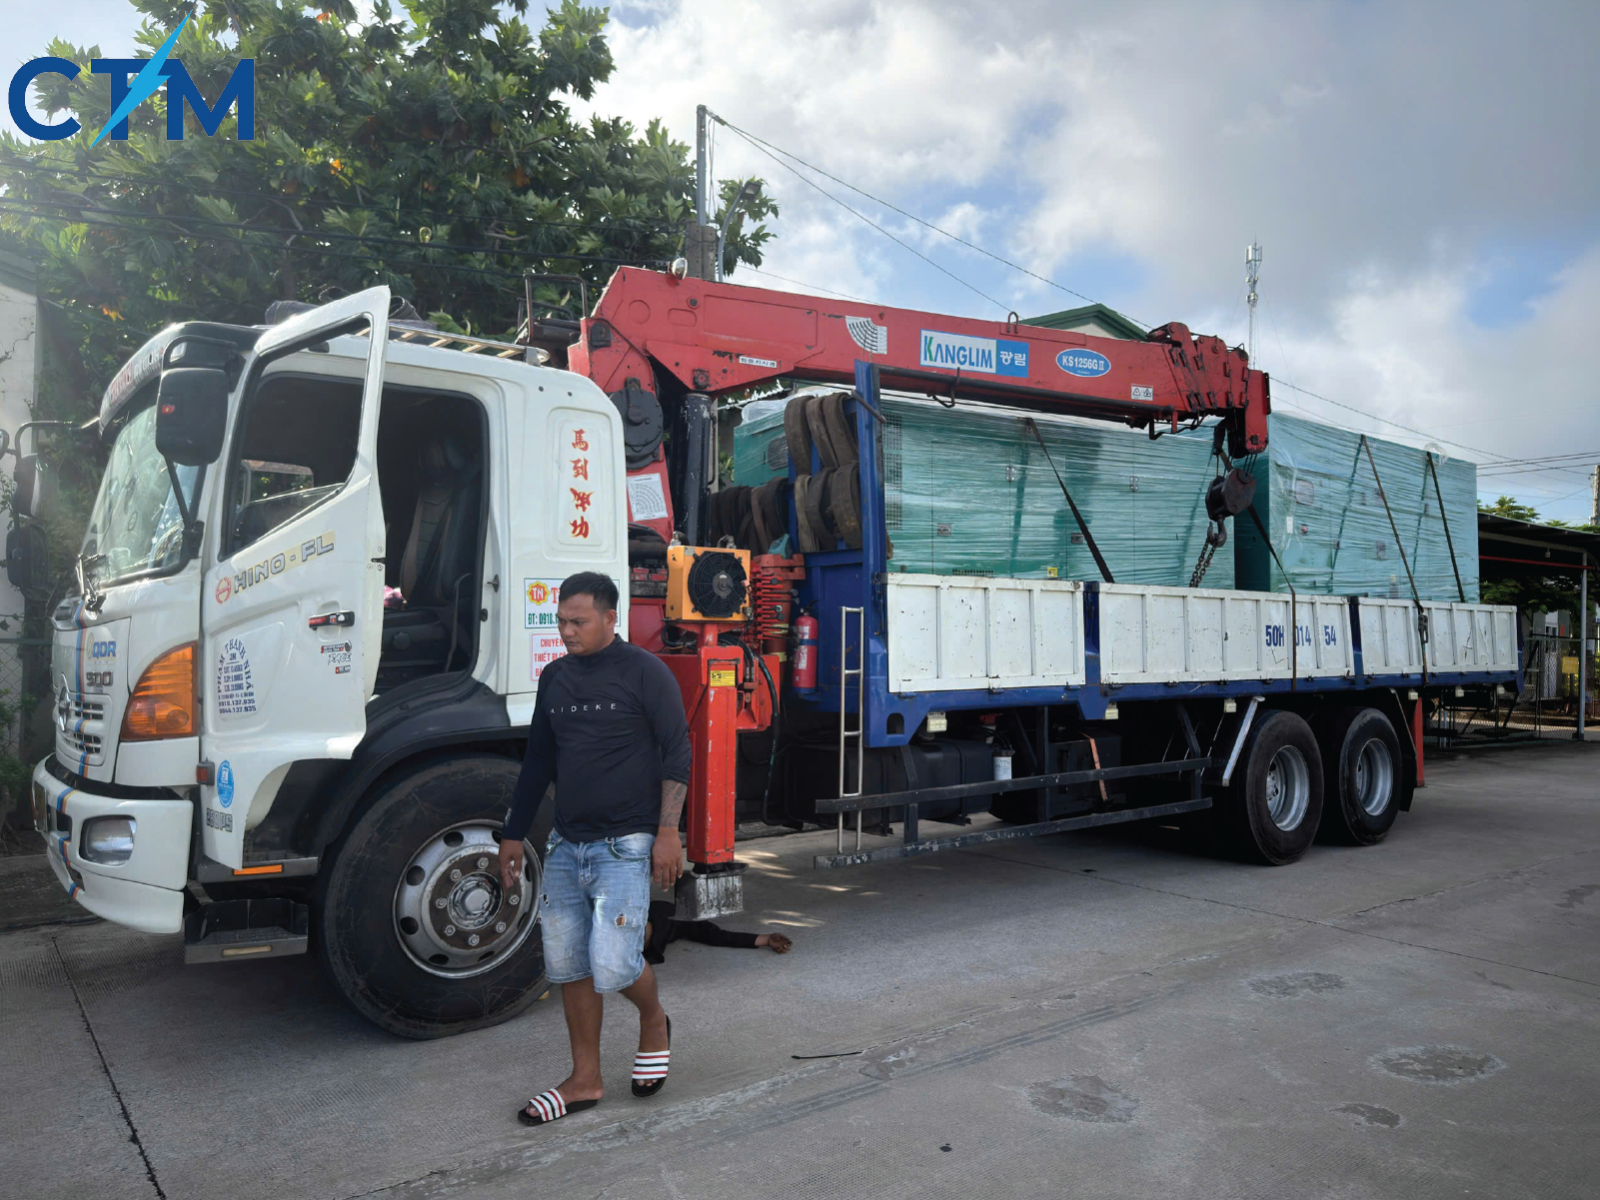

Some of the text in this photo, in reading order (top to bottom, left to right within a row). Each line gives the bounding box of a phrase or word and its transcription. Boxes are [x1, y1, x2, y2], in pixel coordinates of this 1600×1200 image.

[924, 336, 993, 369] KANGLIM
[1000, 351, 1026, 366] 광림
[234, 553, 286, 594] HINO
[301, 536, 335, 562] FL
[532, 587, 544, 598] TN
[1265, 625, 1285, 647] 50H
[1324, 625, 1337, 646] 54
[92, 641, 117, 659] QDR
[86, 671, 114, 687] 500
